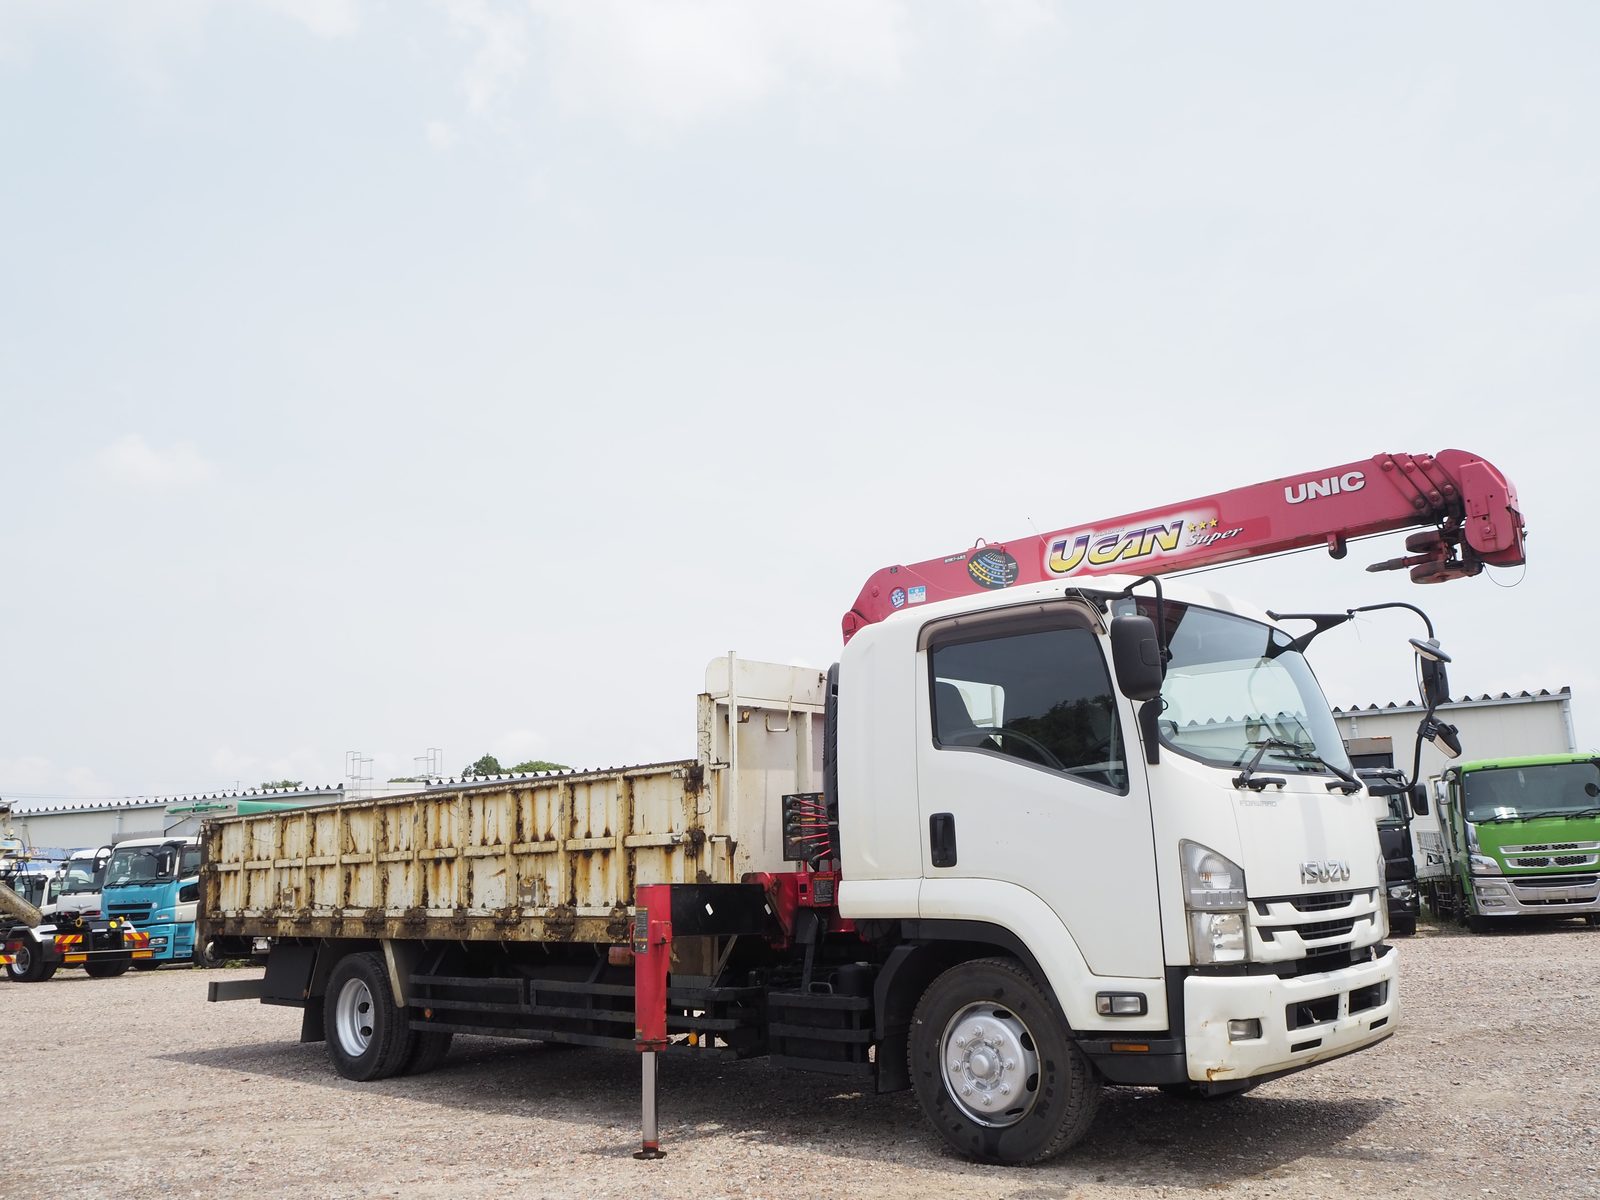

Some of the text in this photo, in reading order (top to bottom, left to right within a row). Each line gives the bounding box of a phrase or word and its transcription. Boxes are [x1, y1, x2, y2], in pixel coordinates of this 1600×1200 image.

[1284, 471, 1366, 504] UNIC
[1048, 519, 1184, 573] UCAN
[1186, 526, 1244, 548] Super
[1299, 860, 1351, 885] ISUZU
